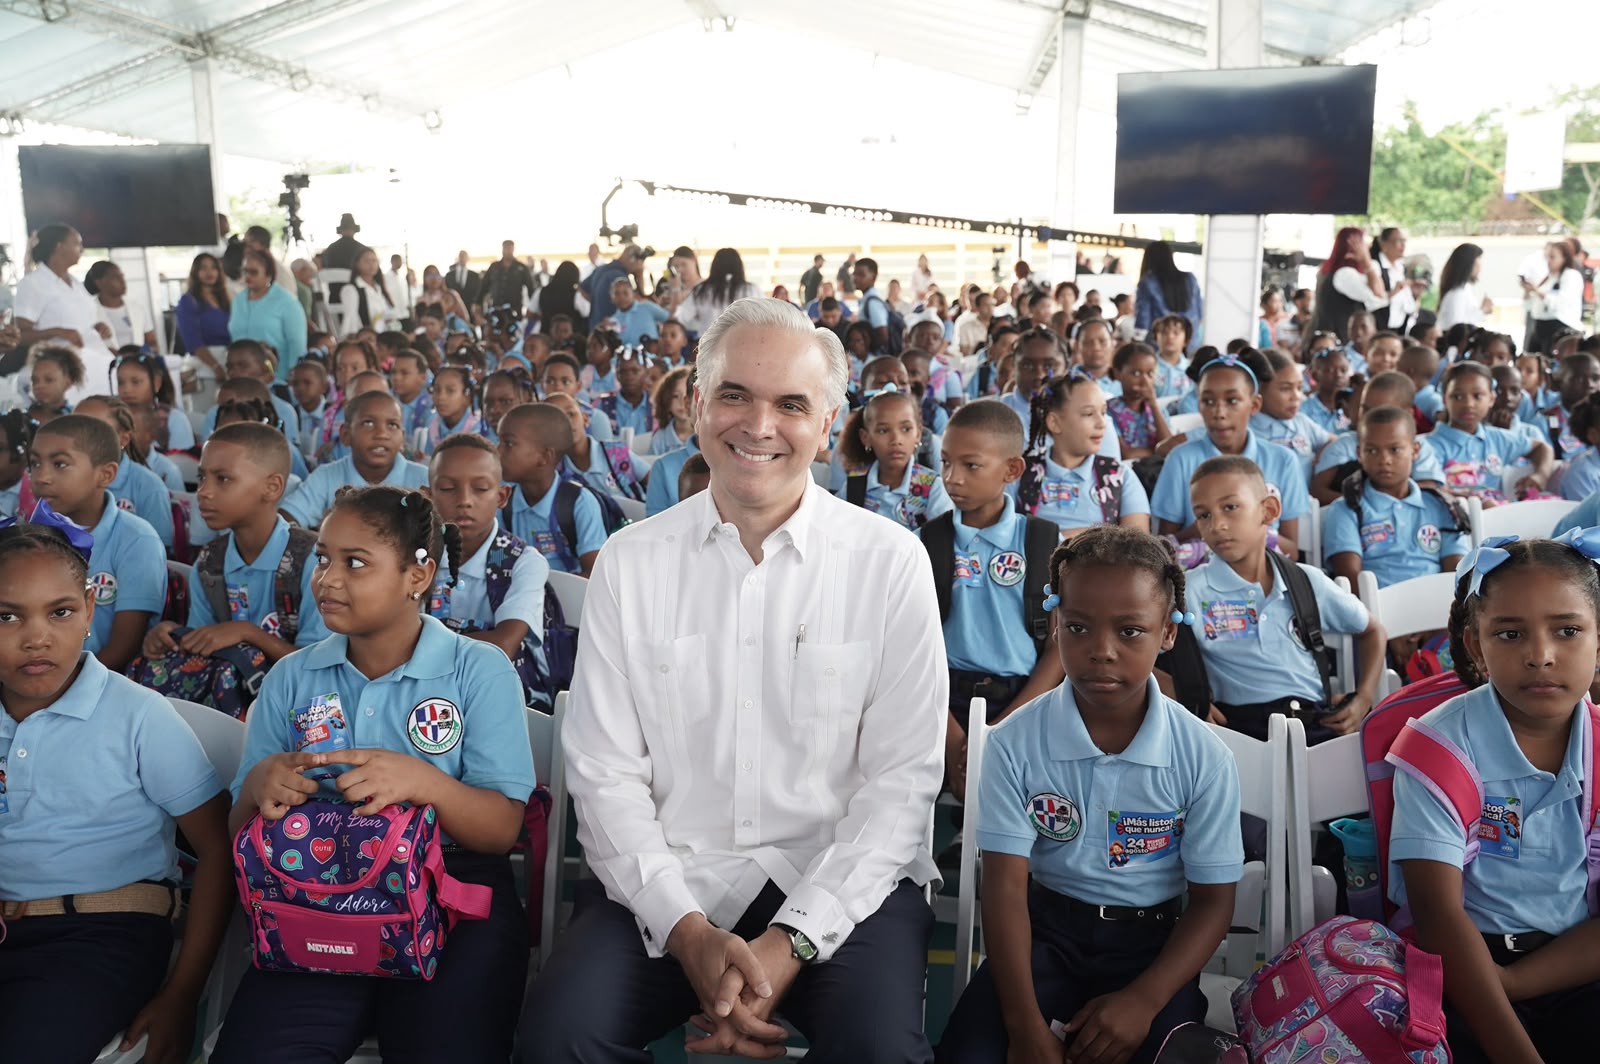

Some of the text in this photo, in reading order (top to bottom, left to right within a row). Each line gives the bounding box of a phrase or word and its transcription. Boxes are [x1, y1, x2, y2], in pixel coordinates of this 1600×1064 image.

[1483, 803, 1504, 813] tos
[1481, 810, 1502, 820] nca!
[316, 812, 344, 834] My
[1122, 816, 1174, 826] ¡Más listos
[1127, 838, 1145, 848] 24
[336, 894, 391, 912] Adore
[306, 942, 354, 954] NOTABLE
